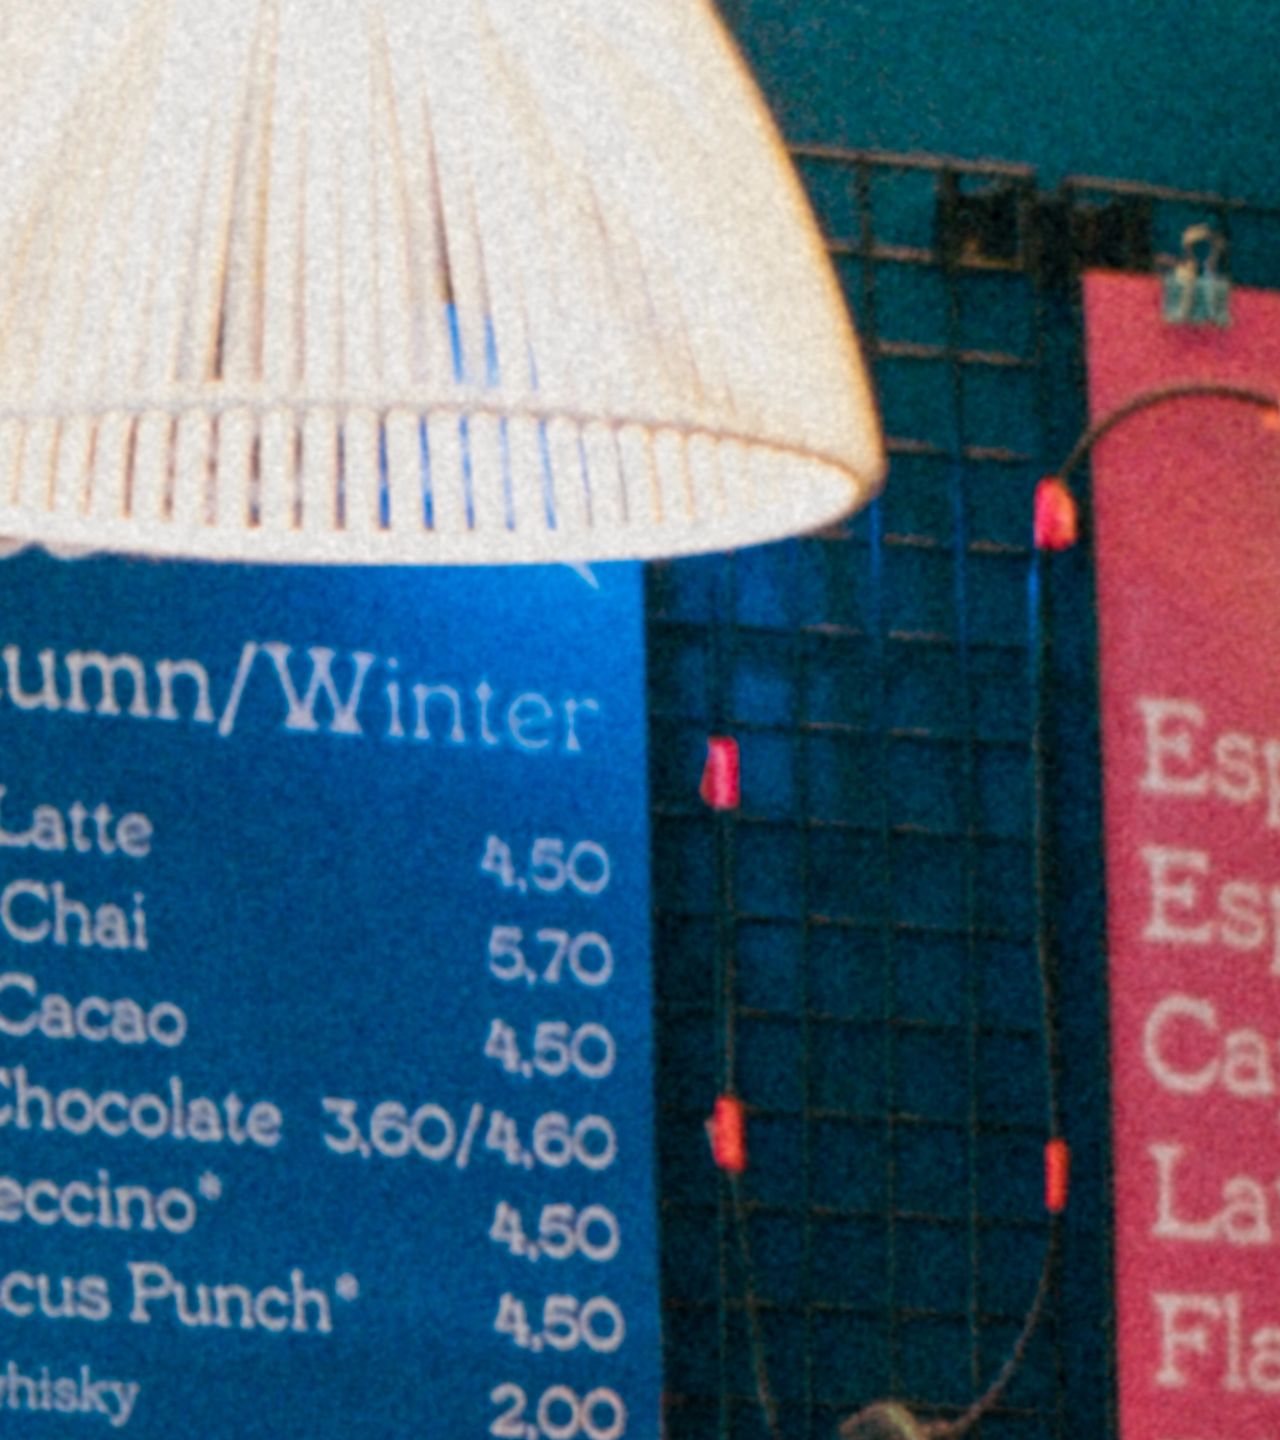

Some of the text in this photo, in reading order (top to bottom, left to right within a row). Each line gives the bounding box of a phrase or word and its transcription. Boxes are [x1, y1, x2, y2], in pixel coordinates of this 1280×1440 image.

[0, 641, 601, 753] umn/Winter
[480, 834, 612, 895] 4,50
[0, 878, 615, 988] Chai 5,70
[0, 972, 617, 1079] Cacao 4,50
[0, 1064, 618, 1171] hocolate 3,60/4,60
[0, 1168, 621, 1263] eccino 4,50
[0, 1269, 112, 1321] cus
[494, 1292, 627, 1354] 4,50
[0, 1360, 140, 1428] hisky
